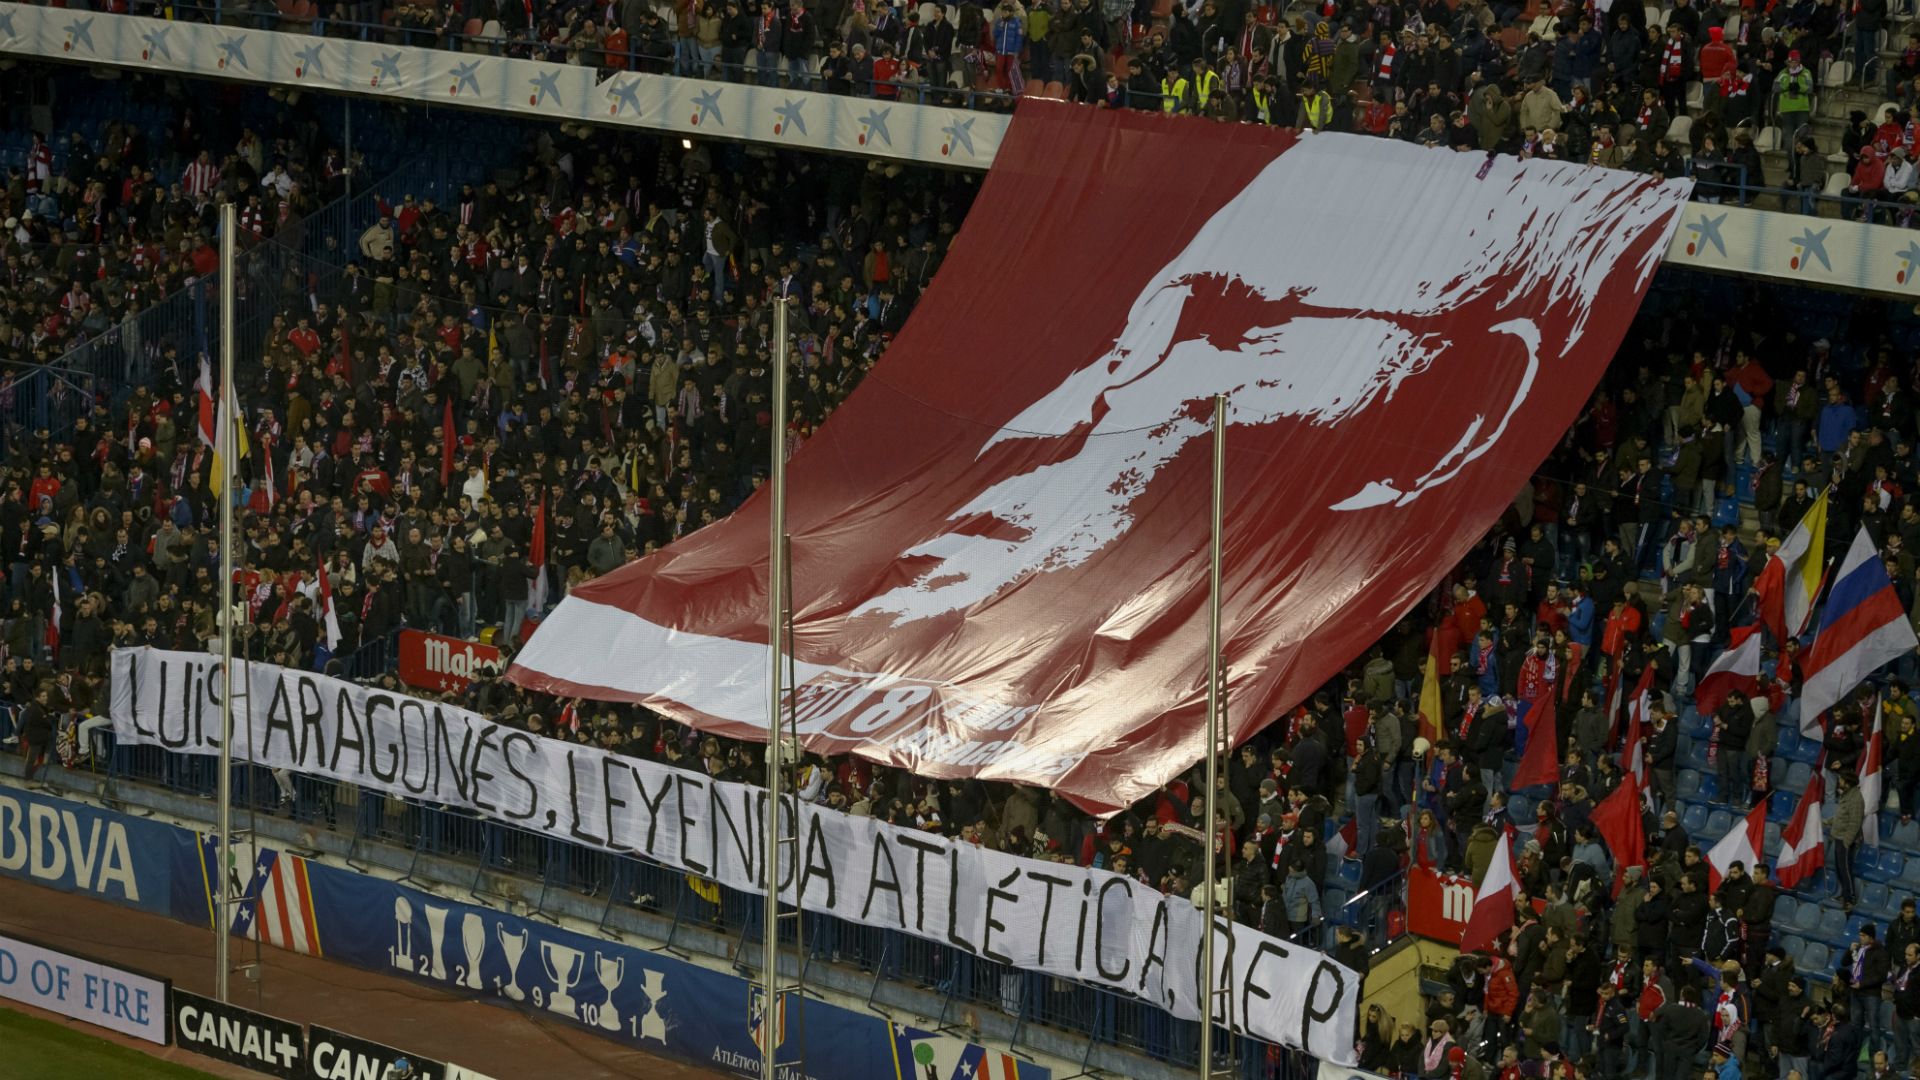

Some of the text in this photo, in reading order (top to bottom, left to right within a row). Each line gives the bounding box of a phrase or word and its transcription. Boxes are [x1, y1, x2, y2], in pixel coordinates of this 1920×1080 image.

[850, 686, 932, 733] 8
[0, 796, 140, 902] BBVA
[31, 960, 70, 1001] OF
[84, 973, 149, 1026] FIRE
[419, 956, 429, 977] 2
[455, 965, 466, 987] 2
[532, 986, 544, 1008] 9
[581, 1002, 599, 1027] 10
[179, 1005, 299, 1069] CANAL+
